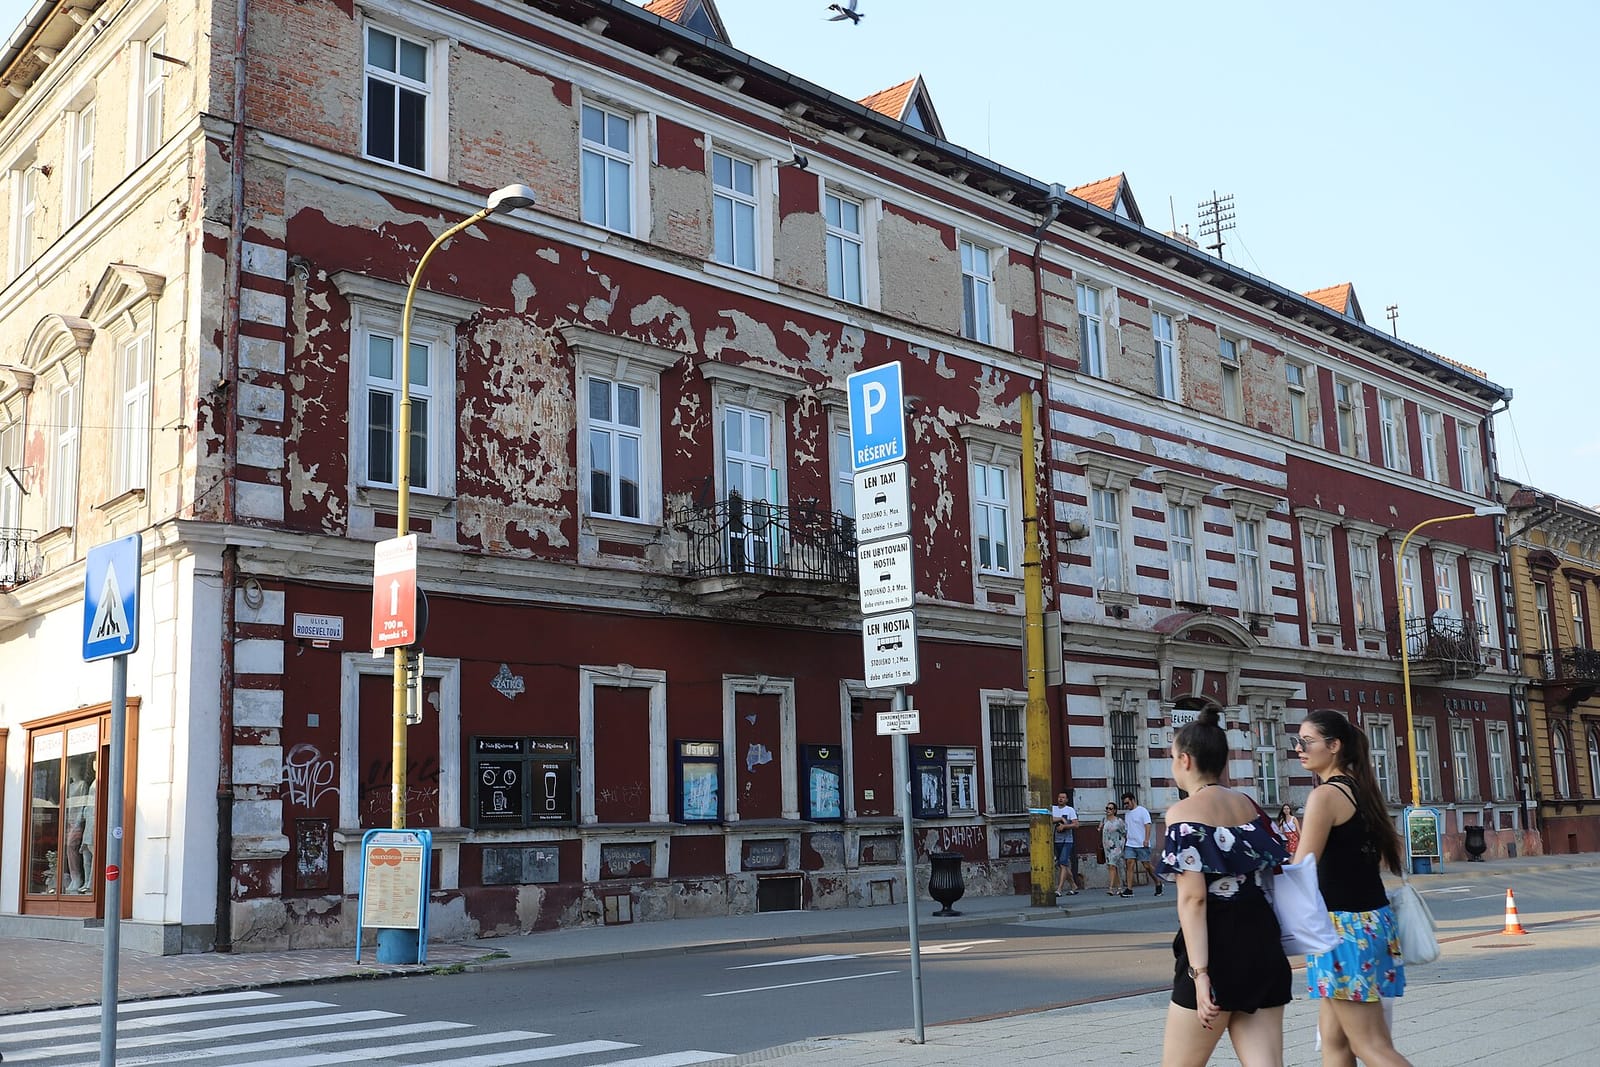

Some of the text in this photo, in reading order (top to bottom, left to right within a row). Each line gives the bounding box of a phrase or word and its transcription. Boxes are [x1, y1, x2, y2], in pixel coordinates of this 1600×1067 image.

[863, 381, 887, 435] P
[858, 437, 898, 464] RÉSERVÉ
[864, 472, 897, 489] LEN TAXI
[862, 510, 883, 520] STOJISKO
[861, 527, 872, 535] doba
[887, 521, 893, 529] 15
[860, 550, 871, 560] LEN
[874, 557, 896, 568] HOSTIA
[864, 587, 886, 597] STOJISKO
[384, 620, 396, 630] 700
[867, 619, 910, 636] LEN HOSTIA
[870, 657, 891, 667] STOJISKO
[870, 673, 880, 681] doba
[686, 742, 714, 755] ÚSMEV
